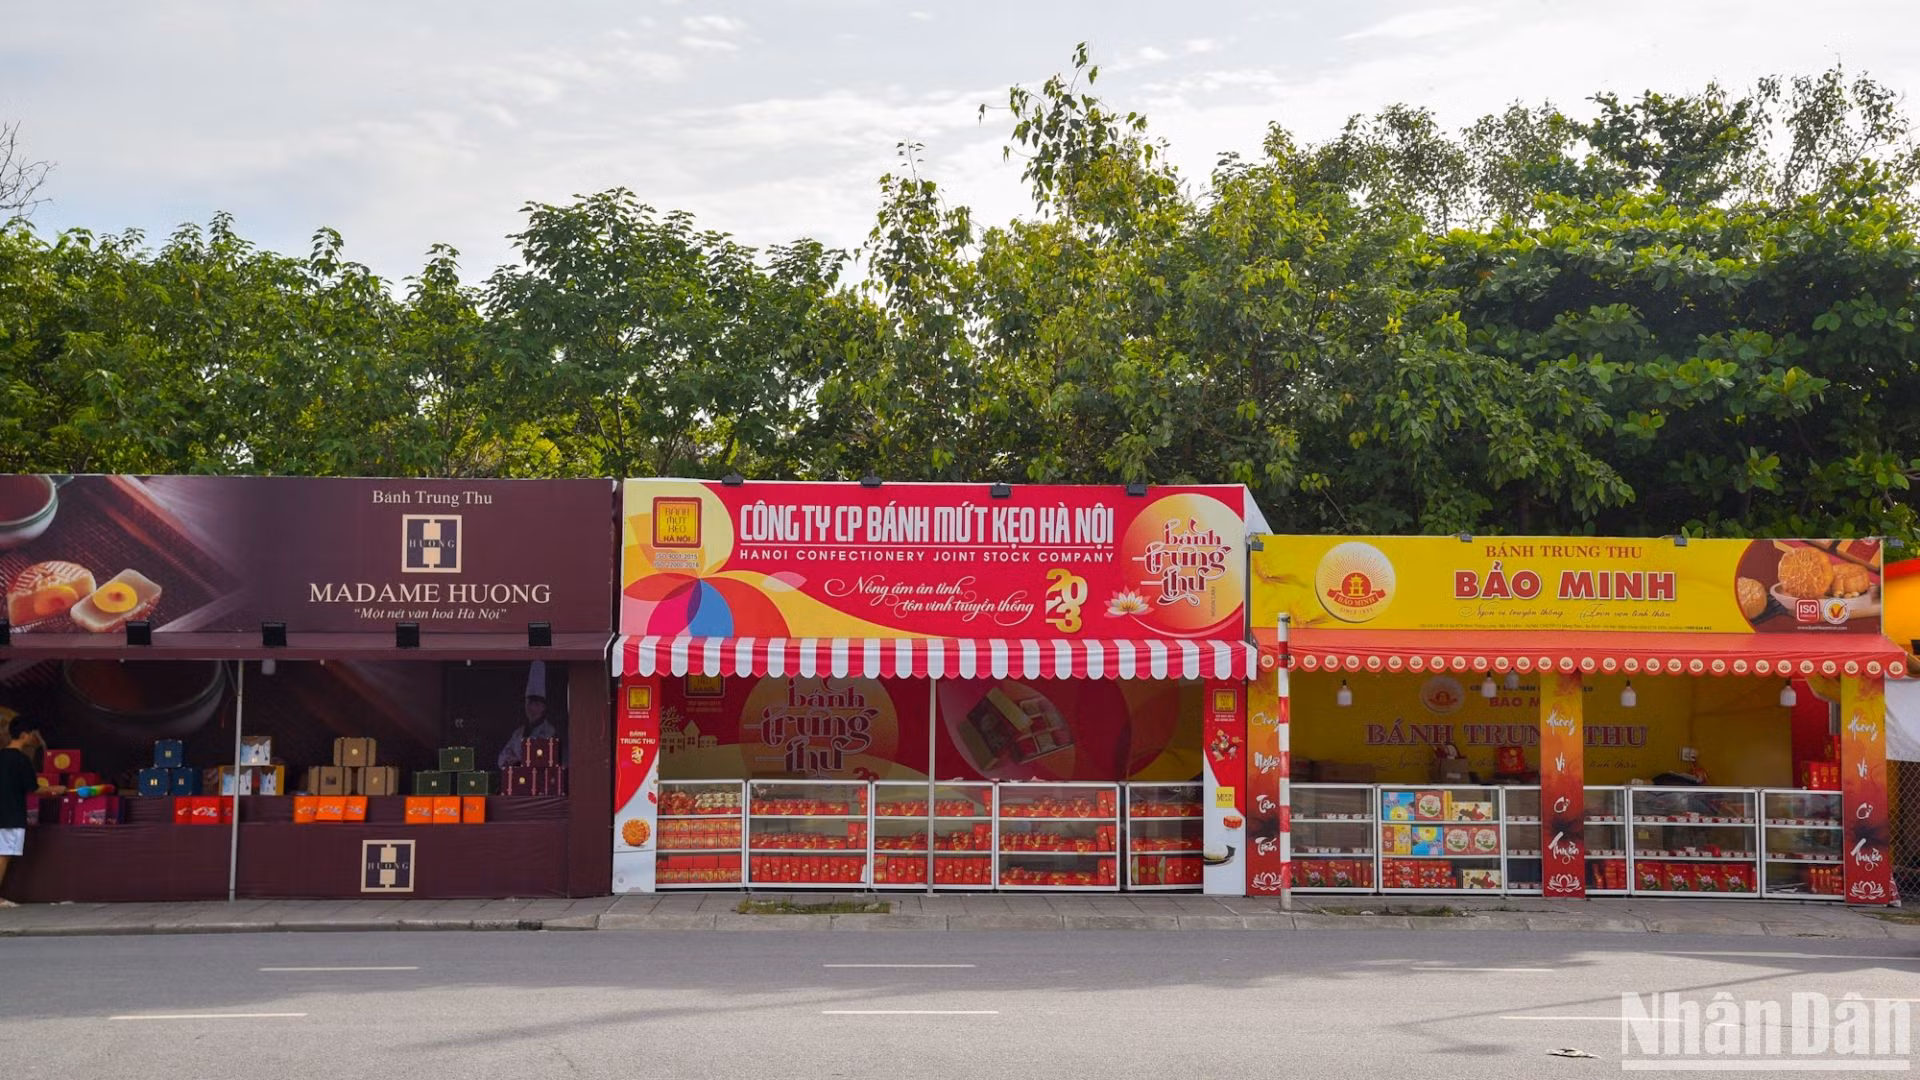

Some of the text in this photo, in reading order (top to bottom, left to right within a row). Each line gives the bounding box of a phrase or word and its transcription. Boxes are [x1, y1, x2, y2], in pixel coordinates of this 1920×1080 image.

[372, 490, 493, 507] Bánh Trung Thu
[740, 500, 1114, 550] CÔNG TY CP BÁNH MỨT KẸO HÀ NỘI
[1163, 518, 1222, 545] bánh
[409, 538, 456, 549] HUONG
[664, 534, 690, 542] HÀ NỘI
[739, 549, 1114, 563] HANOI CONFECTIONERY JOINT STOCK COMPANY
[1132, 541, 1232, 580] trung
[1485, 543, 1643, 559] BÁNH TRUNG THU
[824, 574, 889, 607] Nồng
[891, 581, 913, 595] ấm
[915, 582, 933, 595] ân
[1141, 566, 1209, 606] thu
[1455, 560, 1676, 600] BẢO MINH
[309, 583, 551, 603] MADAME HUONG
[1354, 595, 1376, 606] MINH
[354, 608, 385, 620] “Một
[387, 608, 405, 620] nét
[457, 608, 475, 620] Hà
[478, 608, 507, 620] Nội”
[894, 590, 1035, 627] tôn vinh truyền thống
[1800, 604, 1817, 614] ISO
[787, 677, 866, 708] bánh
[743, 702, 879, 753] trung
[1252, 711, 1280, 733] Công
[1366, 718, 1649, 748] BÁNH TRUN THU
[1546, 709, 1576, 736] Hương
[1847, 714, 1879, 742] Hương
[755, 736, 844, 780] thu
[1254, 751, 1280, 775] Nghệ
[1555, 751, 1566, 773] Vị
[1856, 757, 1868, 780] Vị
[1255, 794, 1276, 814] Tân
